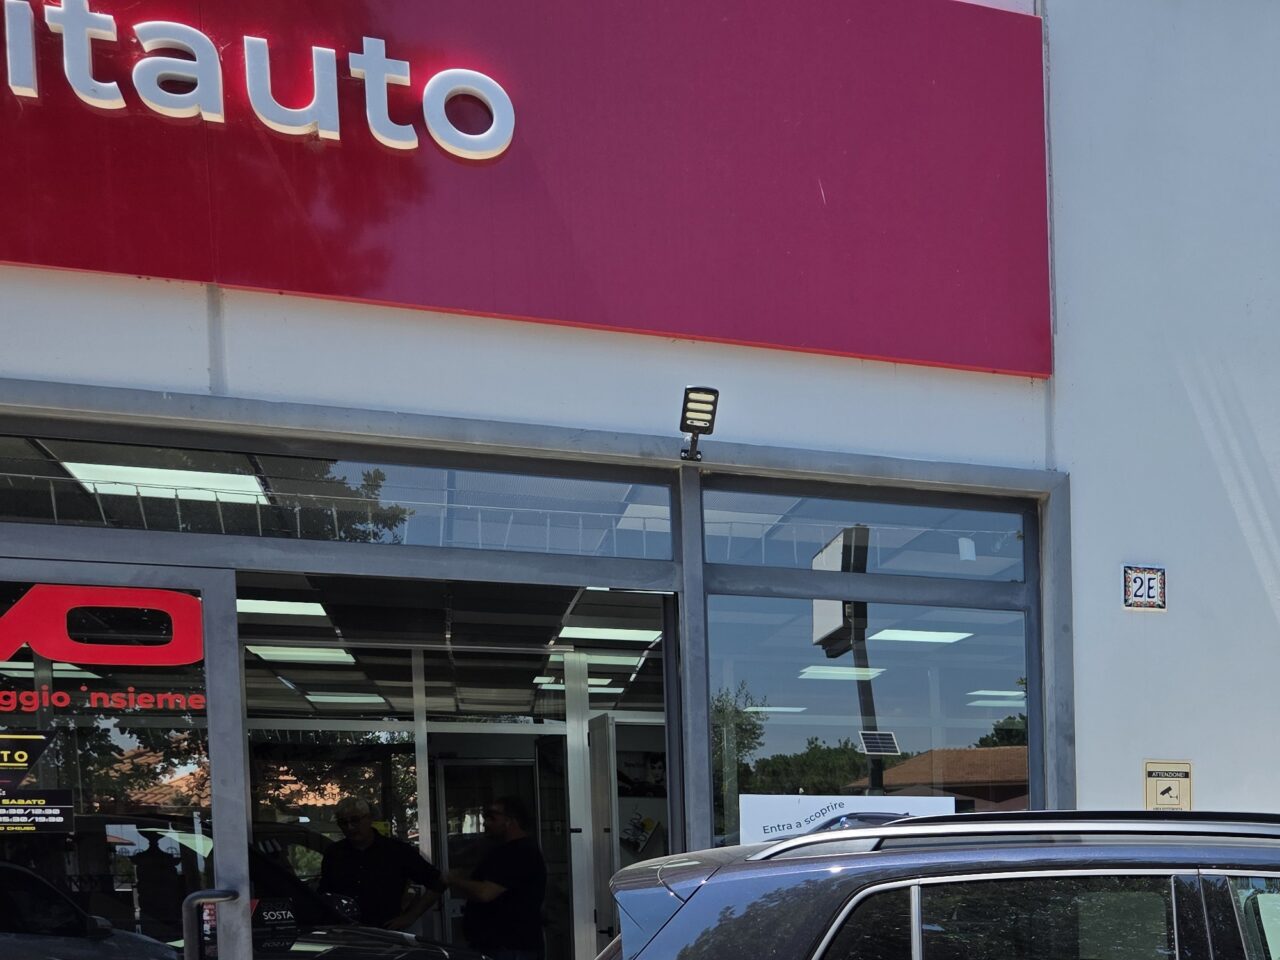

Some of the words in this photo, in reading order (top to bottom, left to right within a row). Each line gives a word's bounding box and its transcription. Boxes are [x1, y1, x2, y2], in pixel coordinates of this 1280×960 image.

[1132, 576, 1157, 599] 2E
[0, 684, 71, 712] ggio
[80, 685, 206, 710] nsieme
[762, 824, 793, 834] Entra
[804, 801, 845, 825] scoprire
[262, 910, 294, 920] SOSTA
